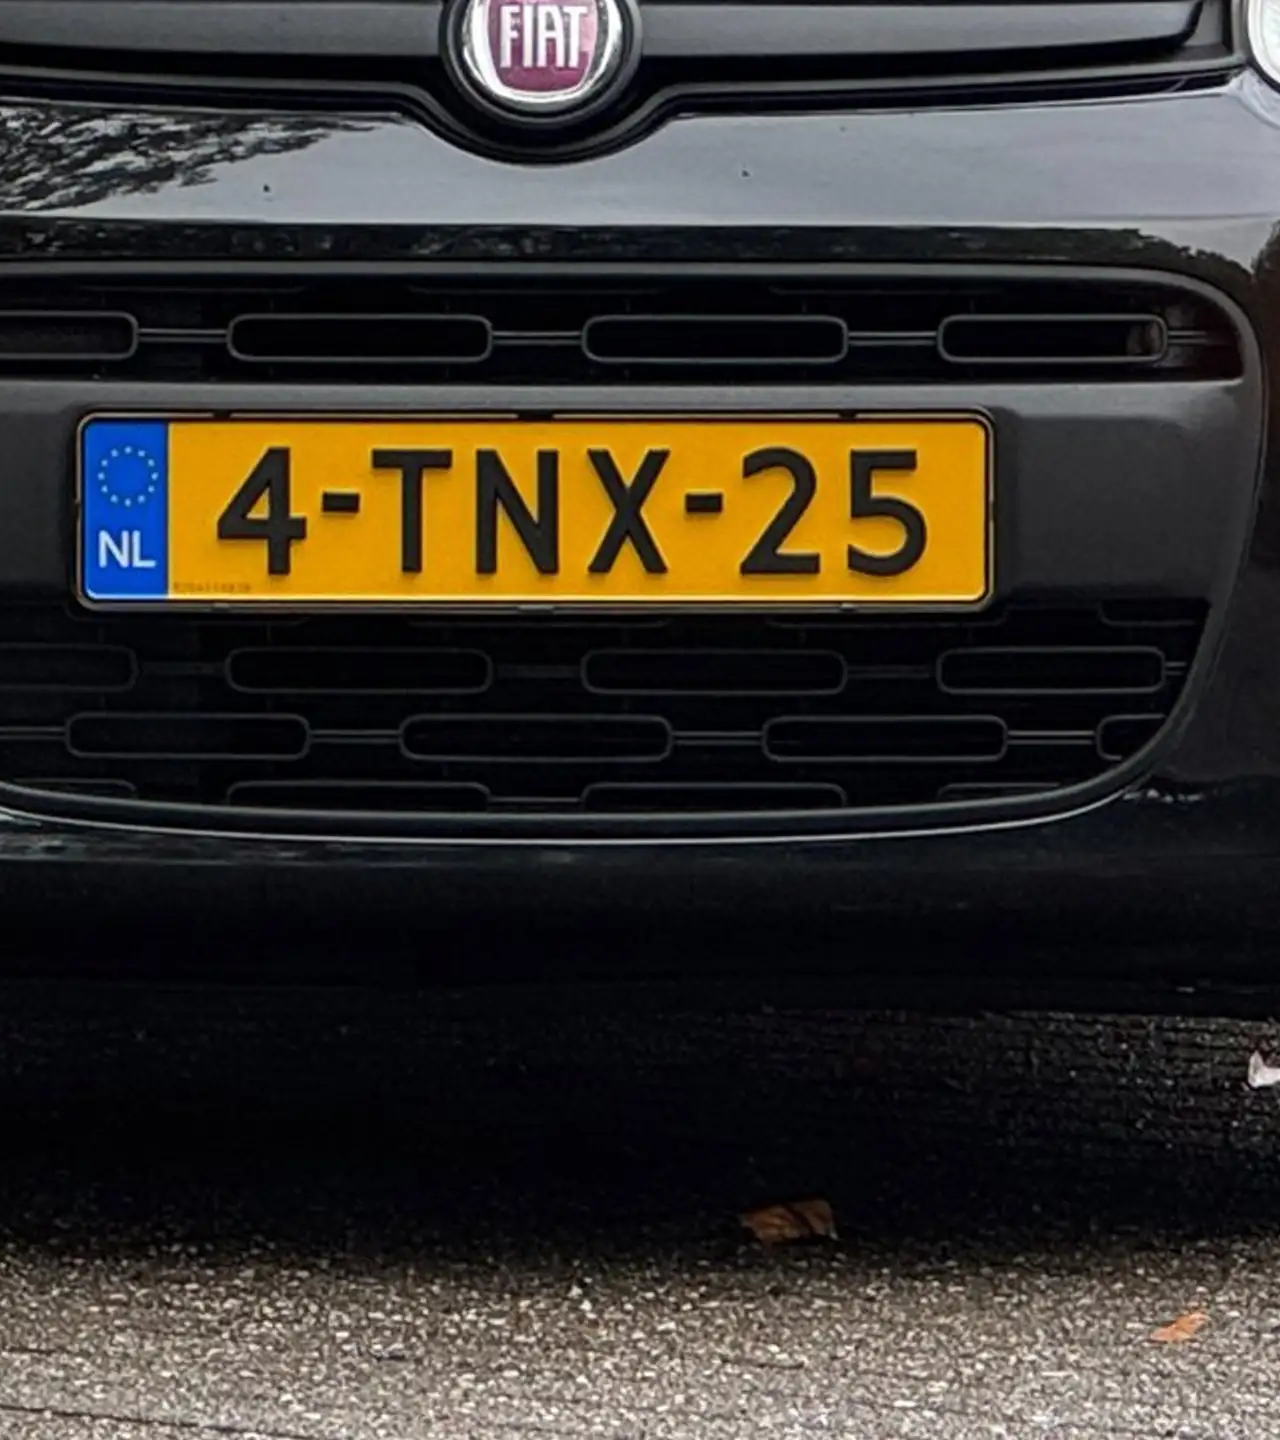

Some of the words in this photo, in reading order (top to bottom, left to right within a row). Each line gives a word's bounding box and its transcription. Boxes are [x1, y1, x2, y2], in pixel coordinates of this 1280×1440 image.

[499, 3, 589, 69] FIAT
[217, 446, 928, 576] 4-TNX-25
[97, 530, 156, 568] NL
